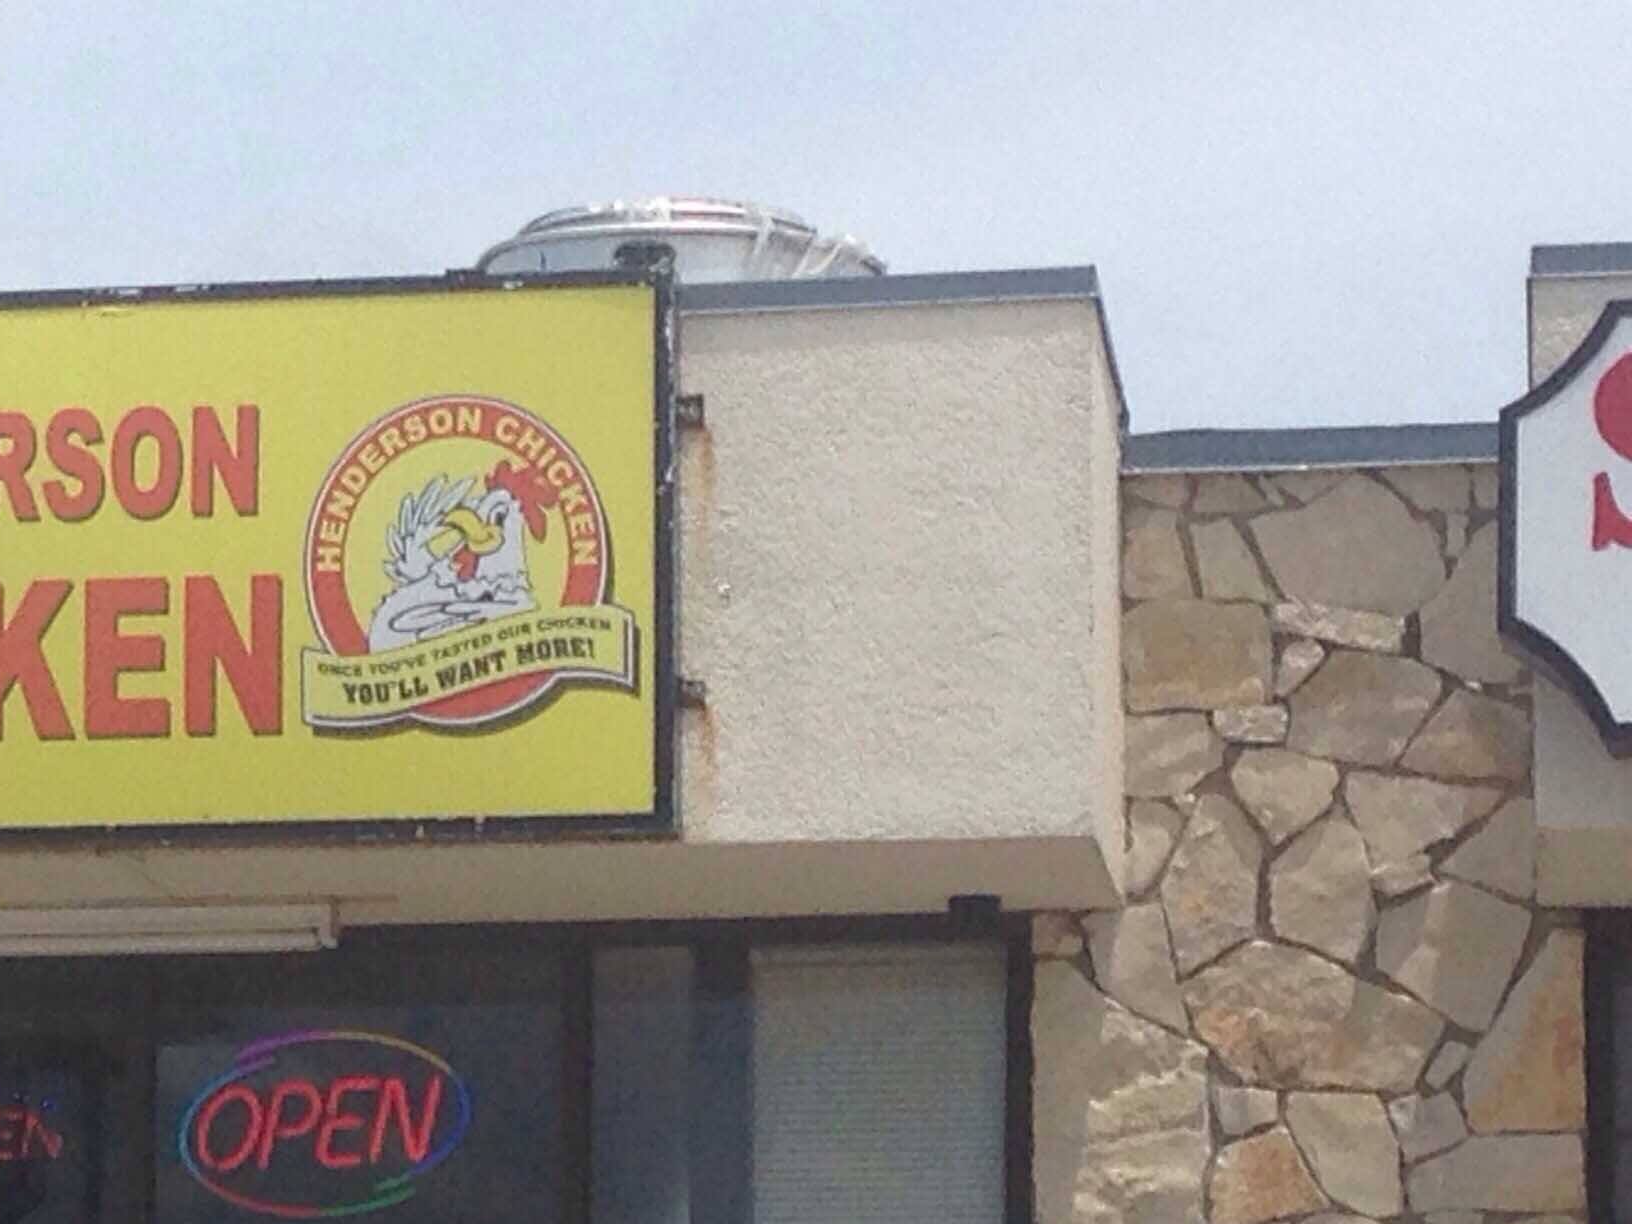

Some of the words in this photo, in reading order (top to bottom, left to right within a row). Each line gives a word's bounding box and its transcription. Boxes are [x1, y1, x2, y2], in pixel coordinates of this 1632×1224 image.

[316, 406, 481, 572] HENDERSON
[494, 416, 599, 567] CHICKEN
[317, 660, 363, 678] ONCE
[432, 633, 493, 662] TASTED
[497, 622, 533, 641] OUR
[536, 616, 611, 632] CHICKEN
[342, 675, 429, 704] YOU'LL
[435, 650, 507, 689] WANT
[517, 635, 595, 666] MORE!
[196, 1074, 442, 1171] OPEN
